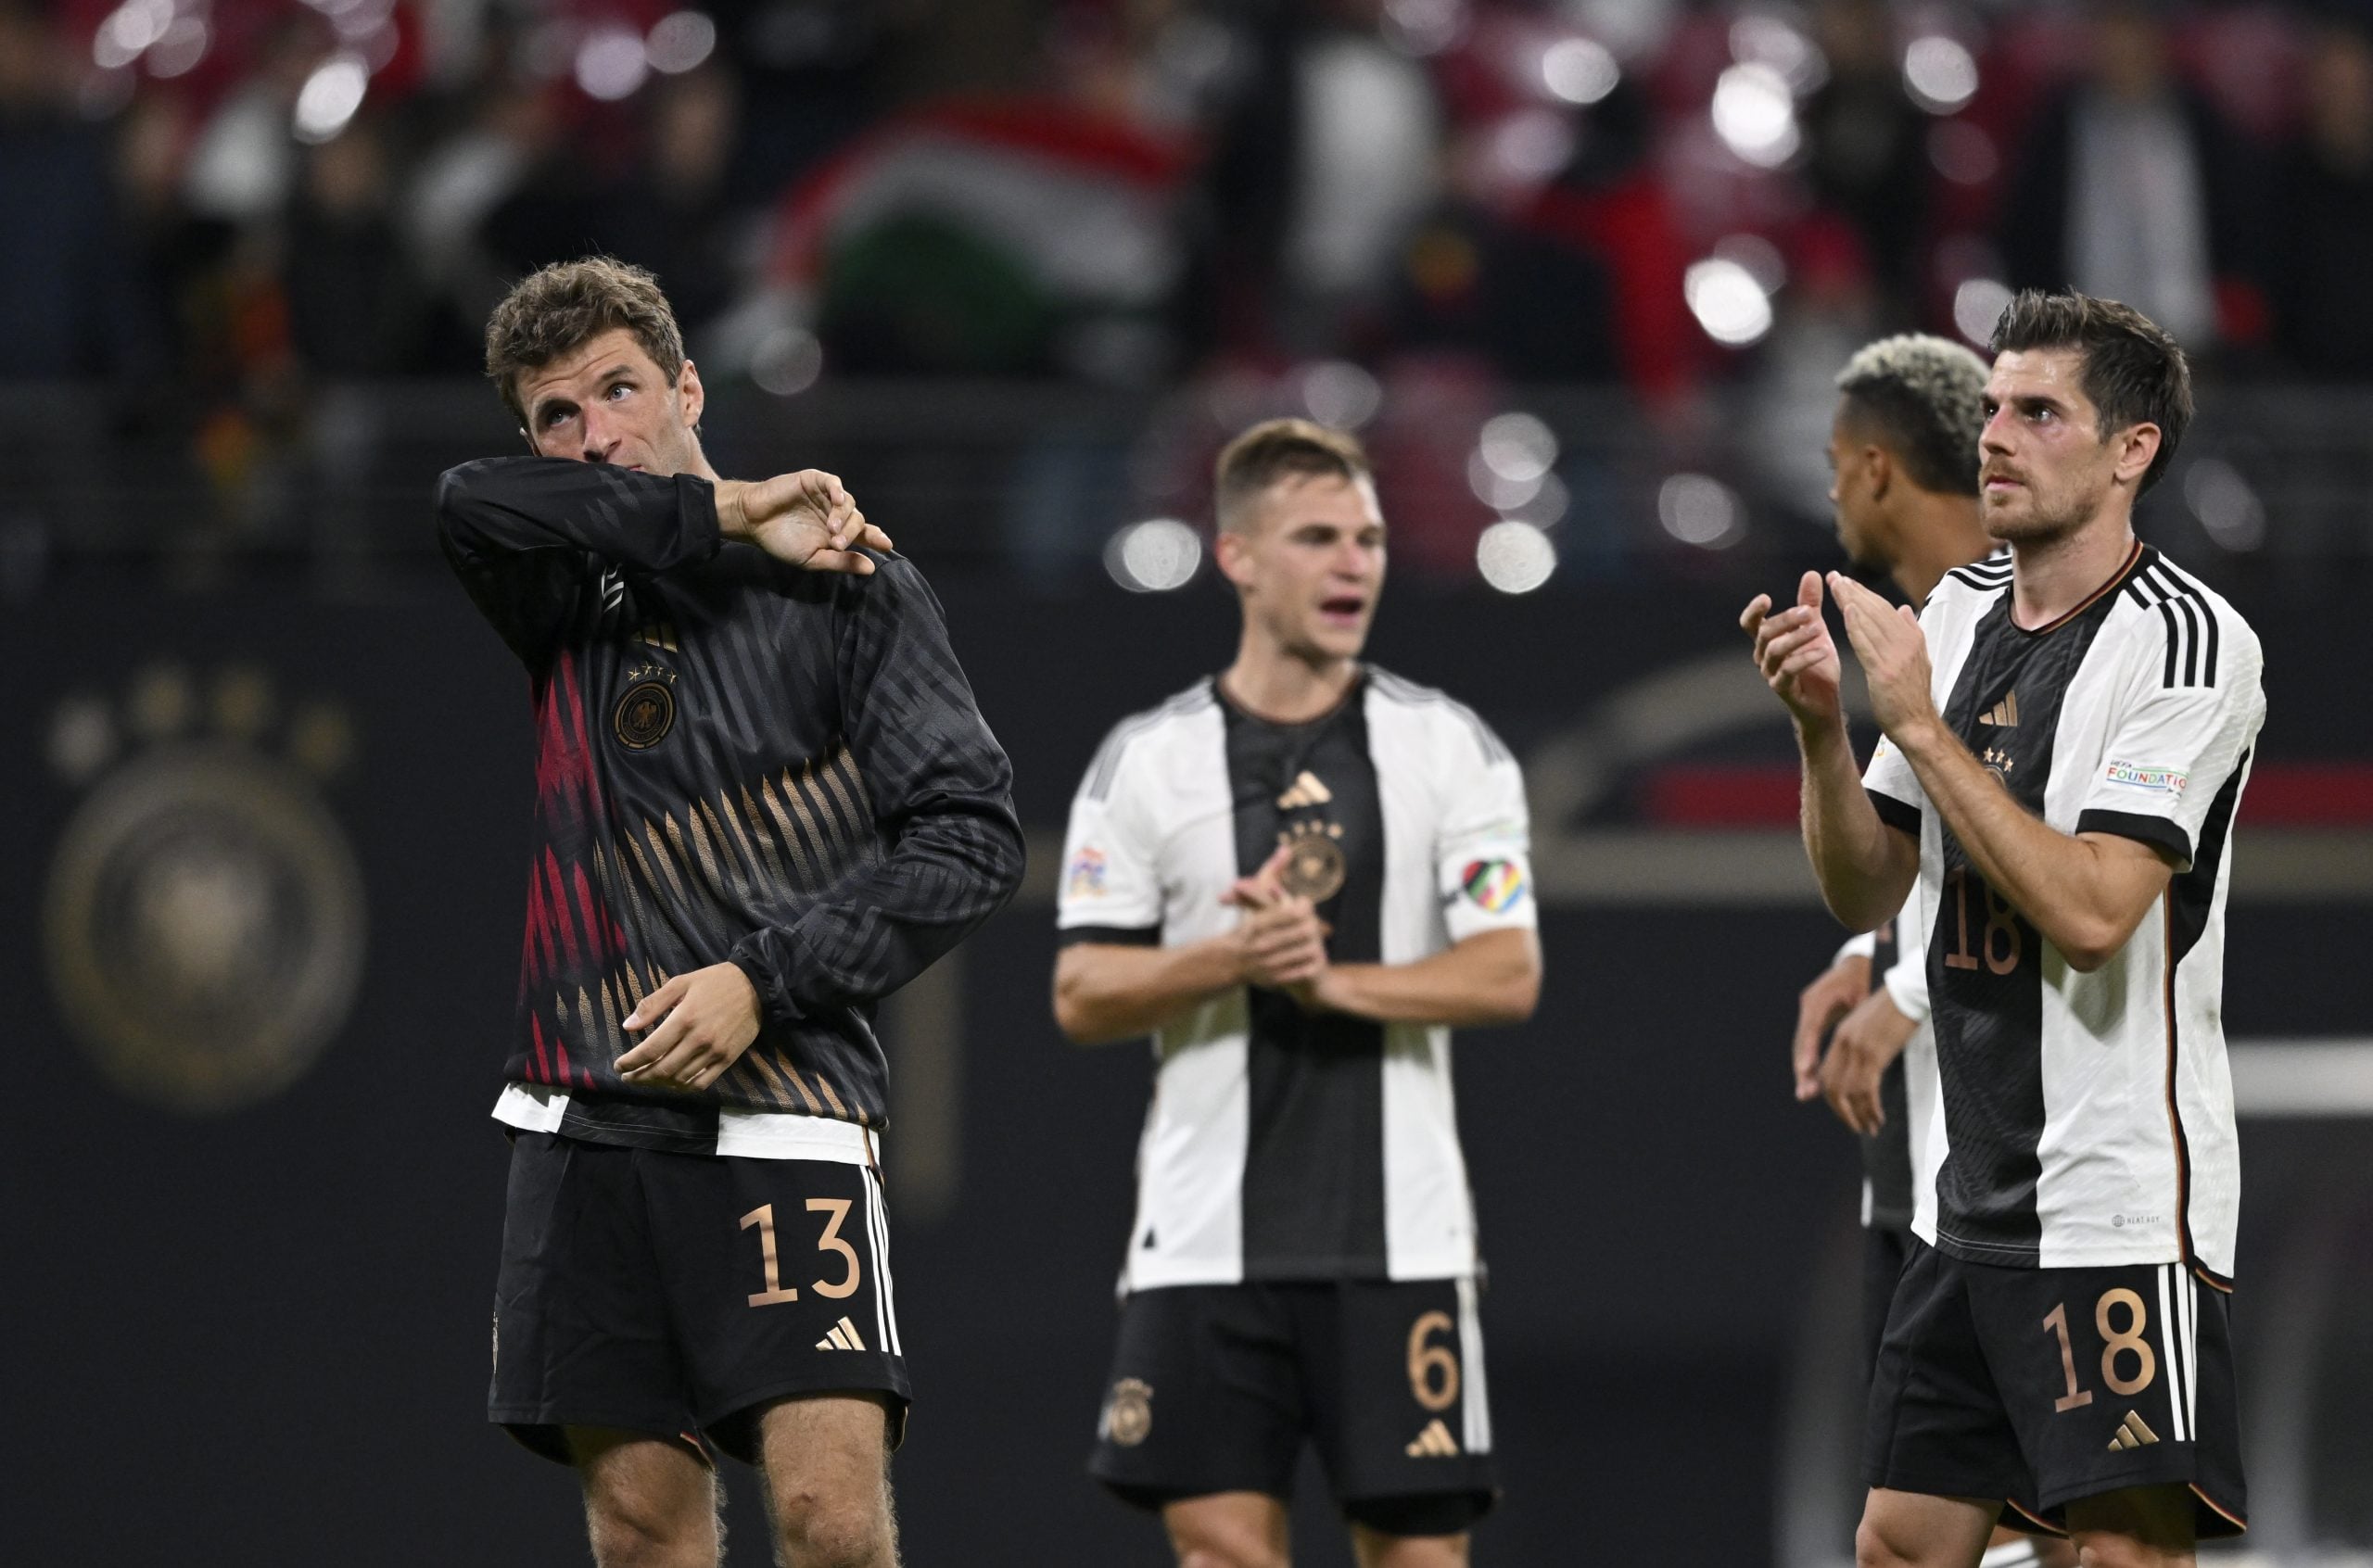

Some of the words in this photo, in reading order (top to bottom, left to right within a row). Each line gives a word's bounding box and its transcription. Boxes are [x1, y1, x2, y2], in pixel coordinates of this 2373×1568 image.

[1943, 864, 2022, 976] 18
[739, 1198, 860, 1308] 13
[1407, 1309, 1460, 1411] 6
[2042, 1287, 2156, 1413] 18
